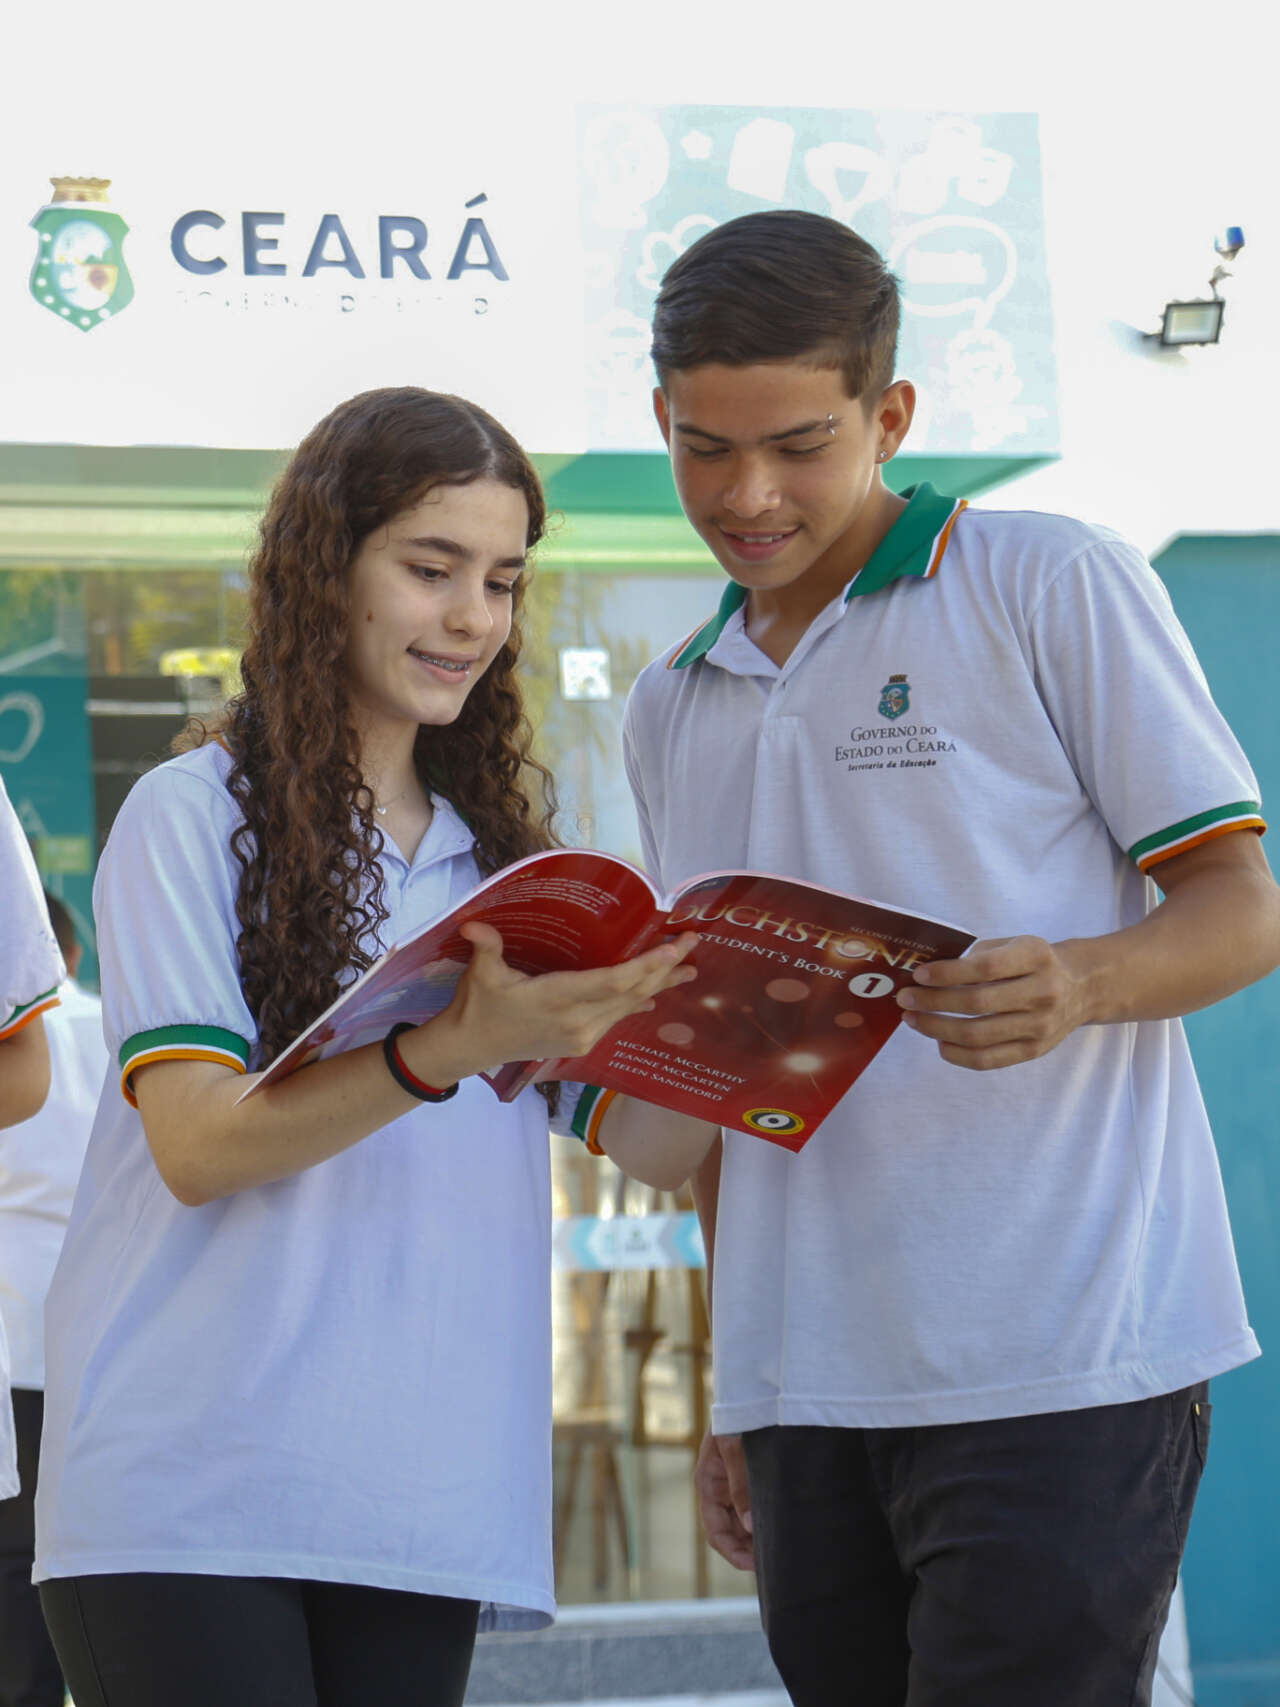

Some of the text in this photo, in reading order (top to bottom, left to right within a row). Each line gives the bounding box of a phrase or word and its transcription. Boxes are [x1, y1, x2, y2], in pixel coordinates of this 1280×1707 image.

[170, 192, 510, 281] CEARÁ
[835, 737, 957, 762] ESTADO DO CEARÁ
[850, 725, 937, 742] GOVERNO DO
[666, 903, 932, 972] OUCHSTONE
[697, 931, 848, 980] STUDENT'S BOOK
[613, 1050, 660, 1068] JEANNE
[616, 1040, 671, 1060] MICHAEL
[608, 1060, 724, 1102] HELEN SANDIFORD
